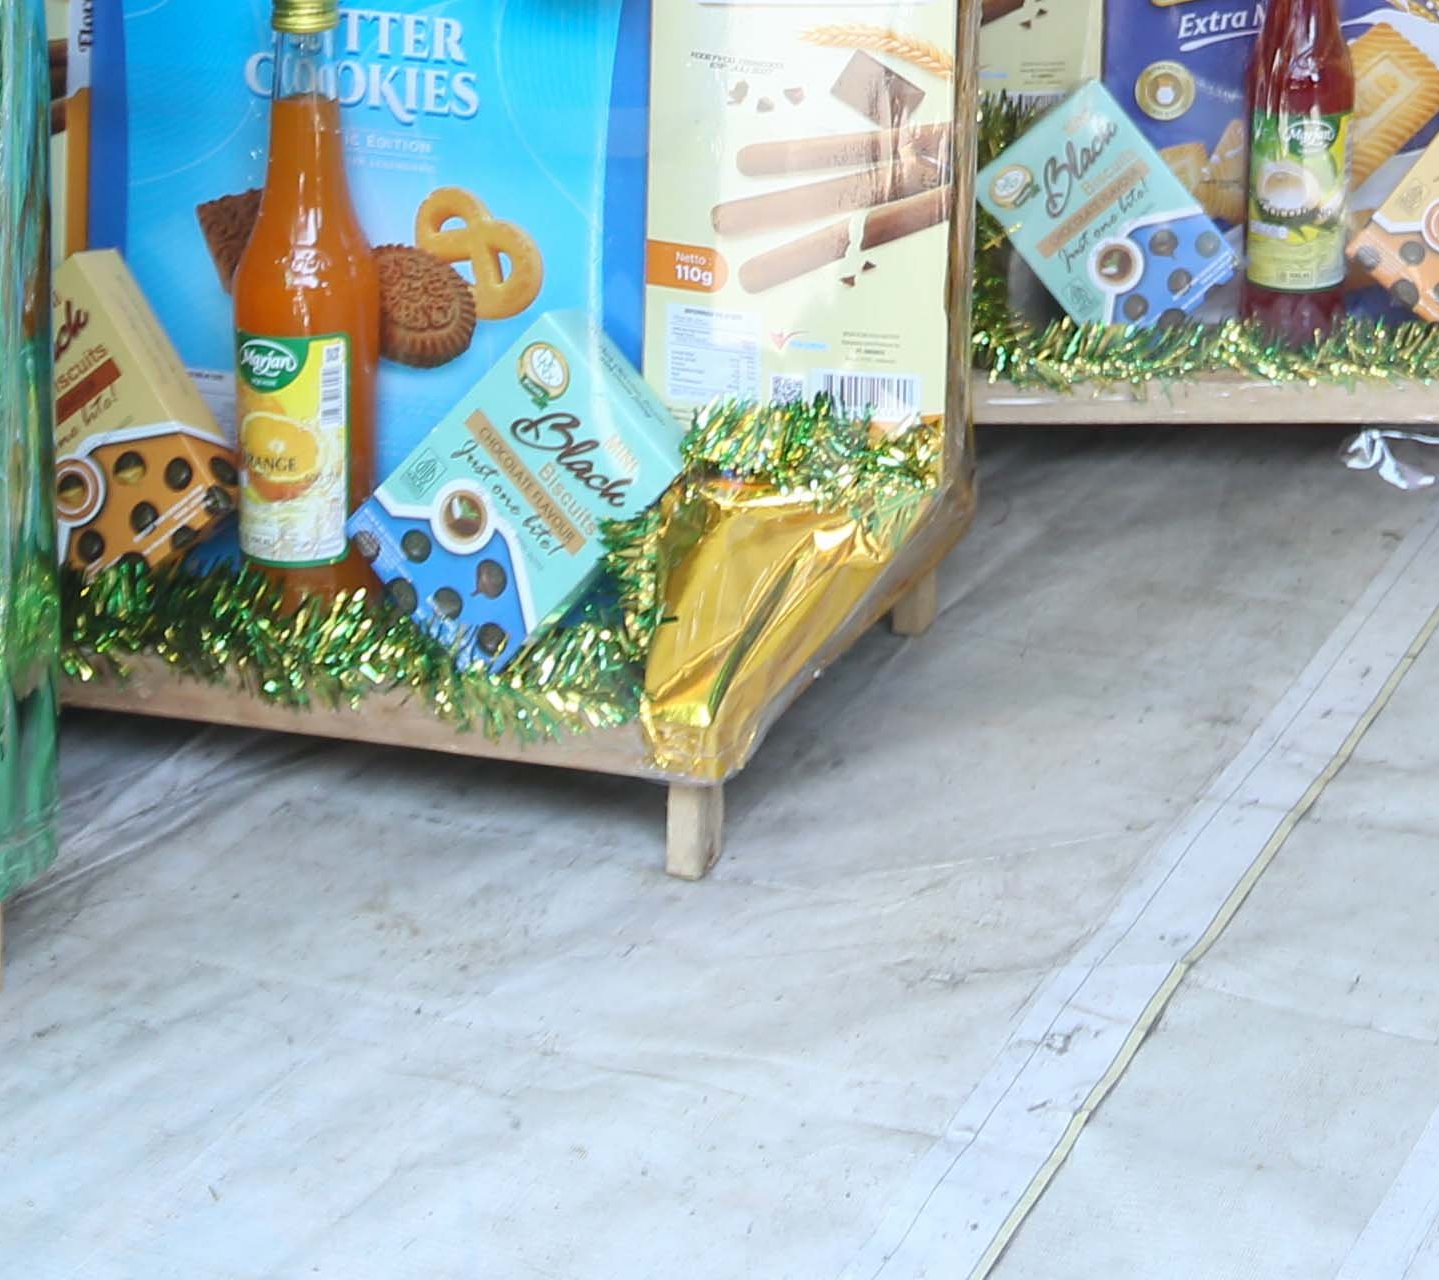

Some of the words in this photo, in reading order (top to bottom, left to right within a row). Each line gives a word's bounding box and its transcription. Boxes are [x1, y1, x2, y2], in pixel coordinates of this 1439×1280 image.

[341, 7, 469, 67] TTER
[1178, 7, 1249, 41] Extra
[1043, 122, 1118, 219] Black
[674, 264, 713, 286] 110g
[458, 439, 497, 484] Just
[493, 480, 526, 514] one
[519, 512, 561, 557] bite!
[476, 423, 543, 498] CHOCOLATE
[531, 486, 581, 546] FLAVOUR
[509, 410, 627, 510] Black
[539, 460, 598, 538] Biscuits
